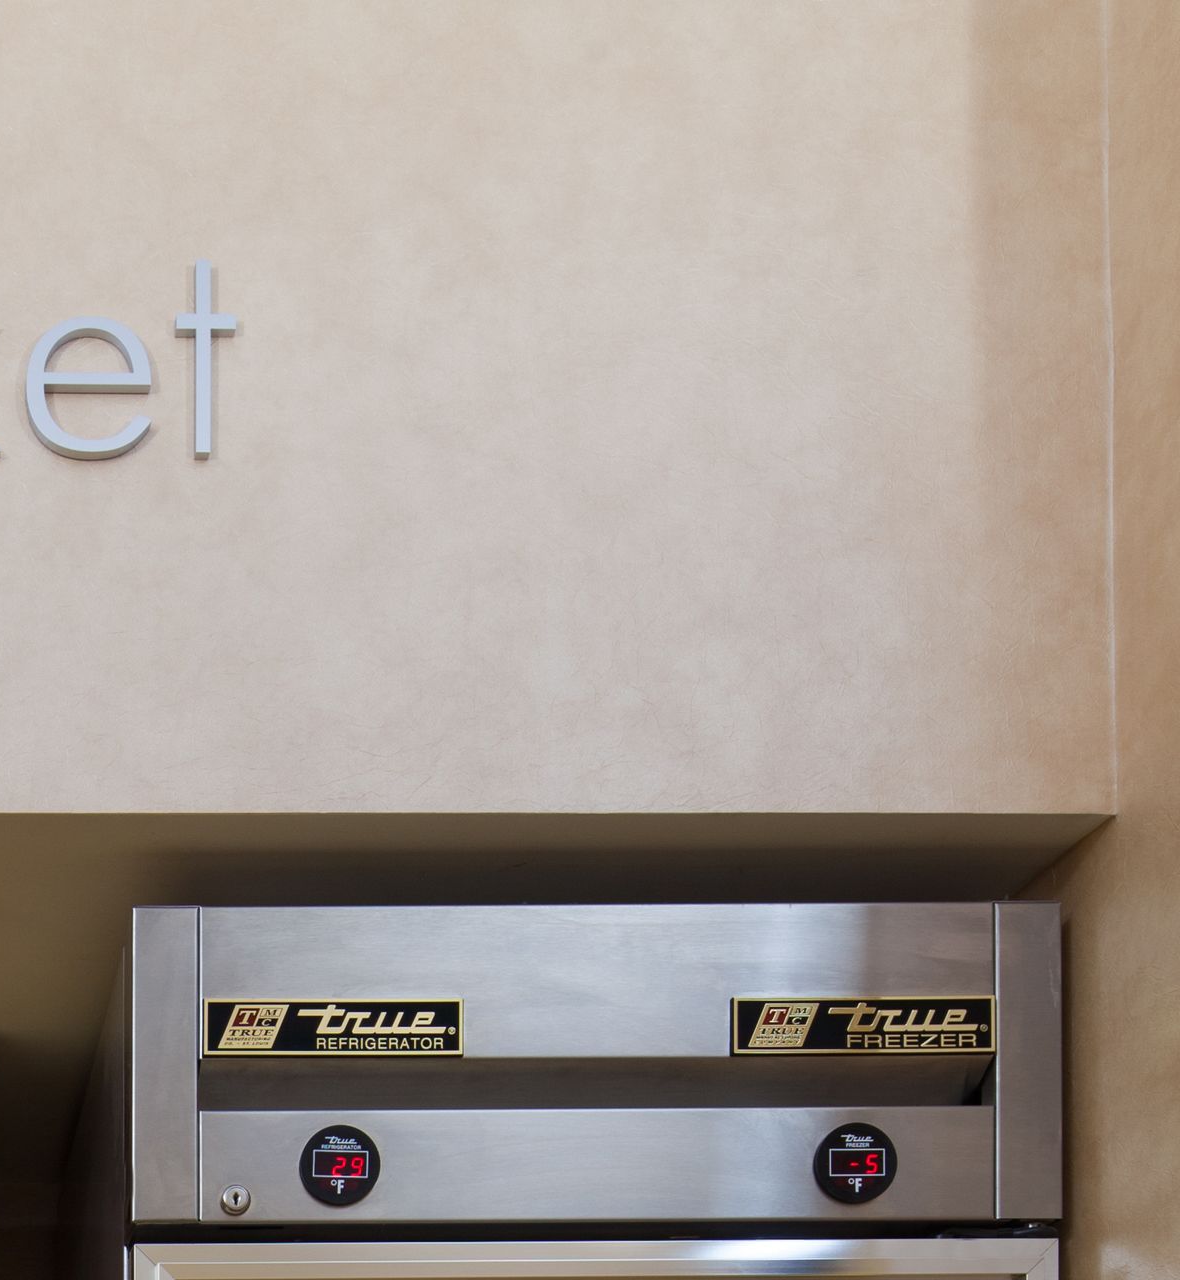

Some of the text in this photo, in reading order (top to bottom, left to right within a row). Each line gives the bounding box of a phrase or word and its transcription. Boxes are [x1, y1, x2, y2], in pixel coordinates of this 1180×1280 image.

[296, 1003, 448, 1035] true
[827, 1001, 980, 1033] true
[228, 1029, 275, 1037] TRUE
[846, 1033, 978, 1048] FREEZER
[315, 1037, 445, 1050] REFRIGERATOR
[331, 1156, 365, 1177] 29
